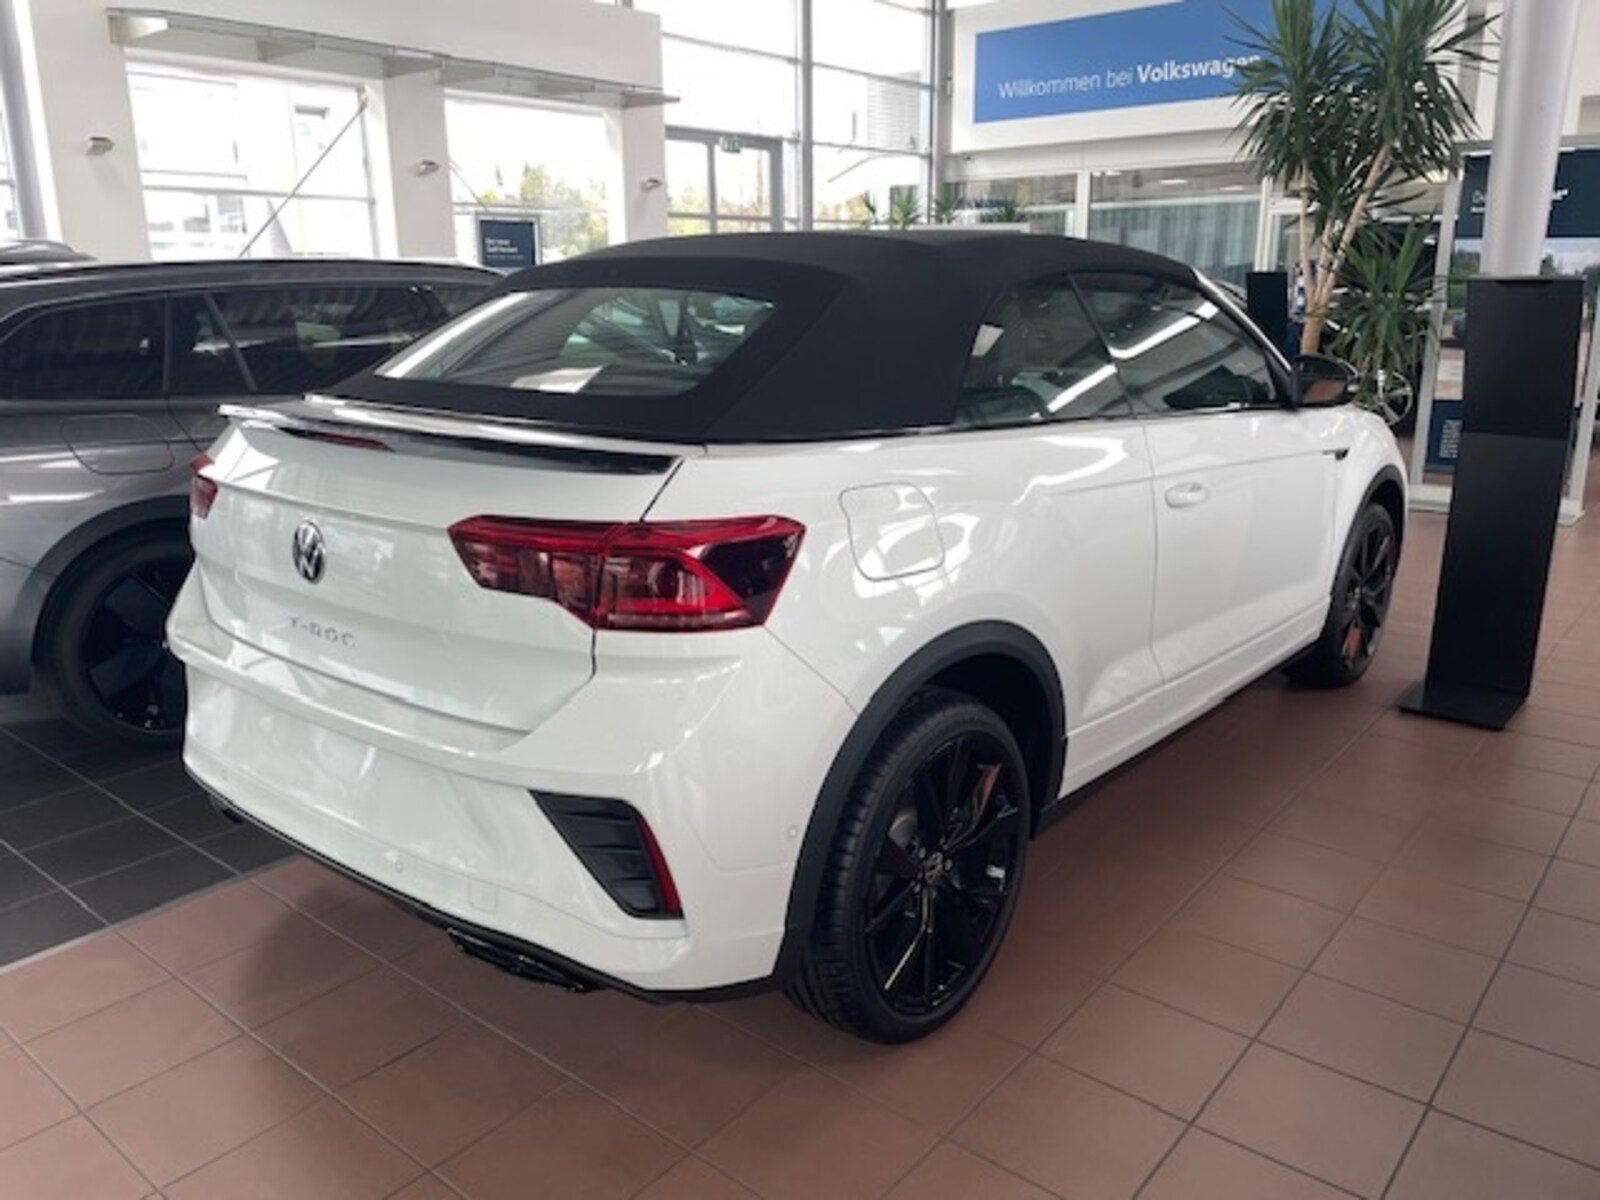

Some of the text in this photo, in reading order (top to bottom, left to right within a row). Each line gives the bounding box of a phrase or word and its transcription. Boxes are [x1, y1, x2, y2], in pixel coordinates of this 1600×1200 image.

[997, 74, 1101, 98] Willkommen
[1106, 67, 1134, 89] bei
[290, 616, 357, 649] T-ROC
